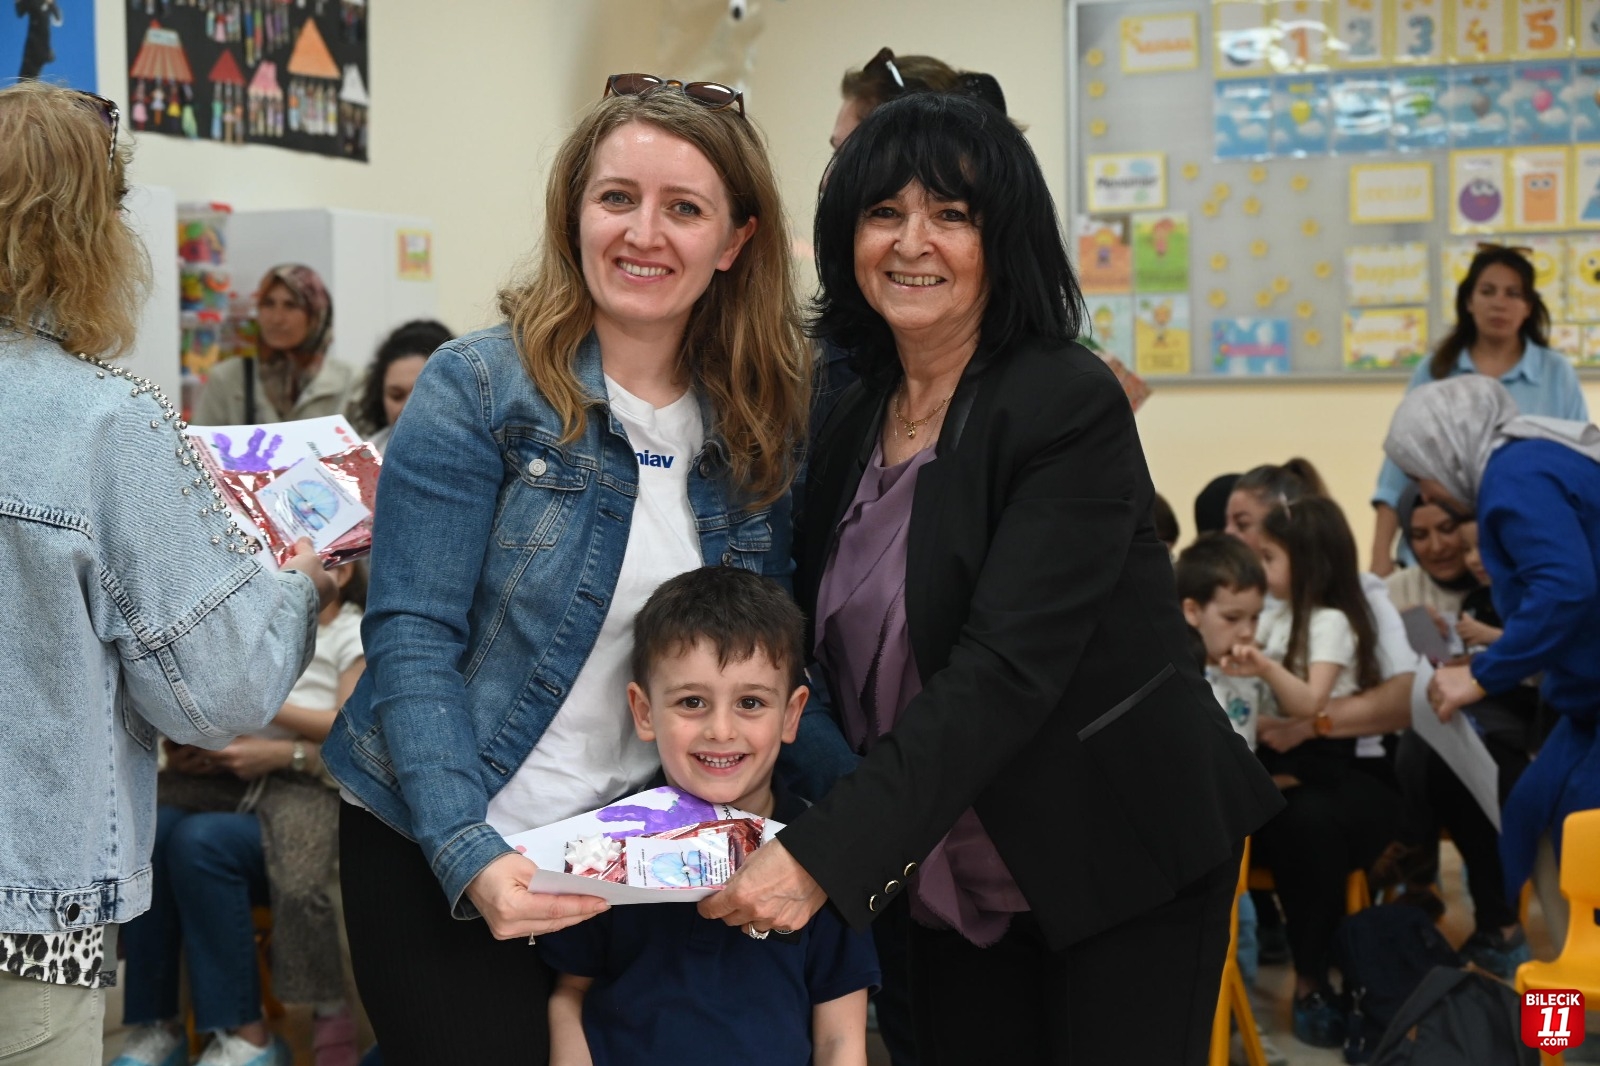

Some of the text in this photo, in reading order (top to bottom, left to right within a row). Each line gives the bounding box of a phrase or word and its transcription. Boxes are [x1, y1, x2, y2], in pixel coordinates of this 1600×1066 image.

[1348, 17, 1376, 55] 2
[1408, 15, 1434, 54] 3
[1465, 18, 1489, 53] 4
[1525, 9, 1558, 50] 5
